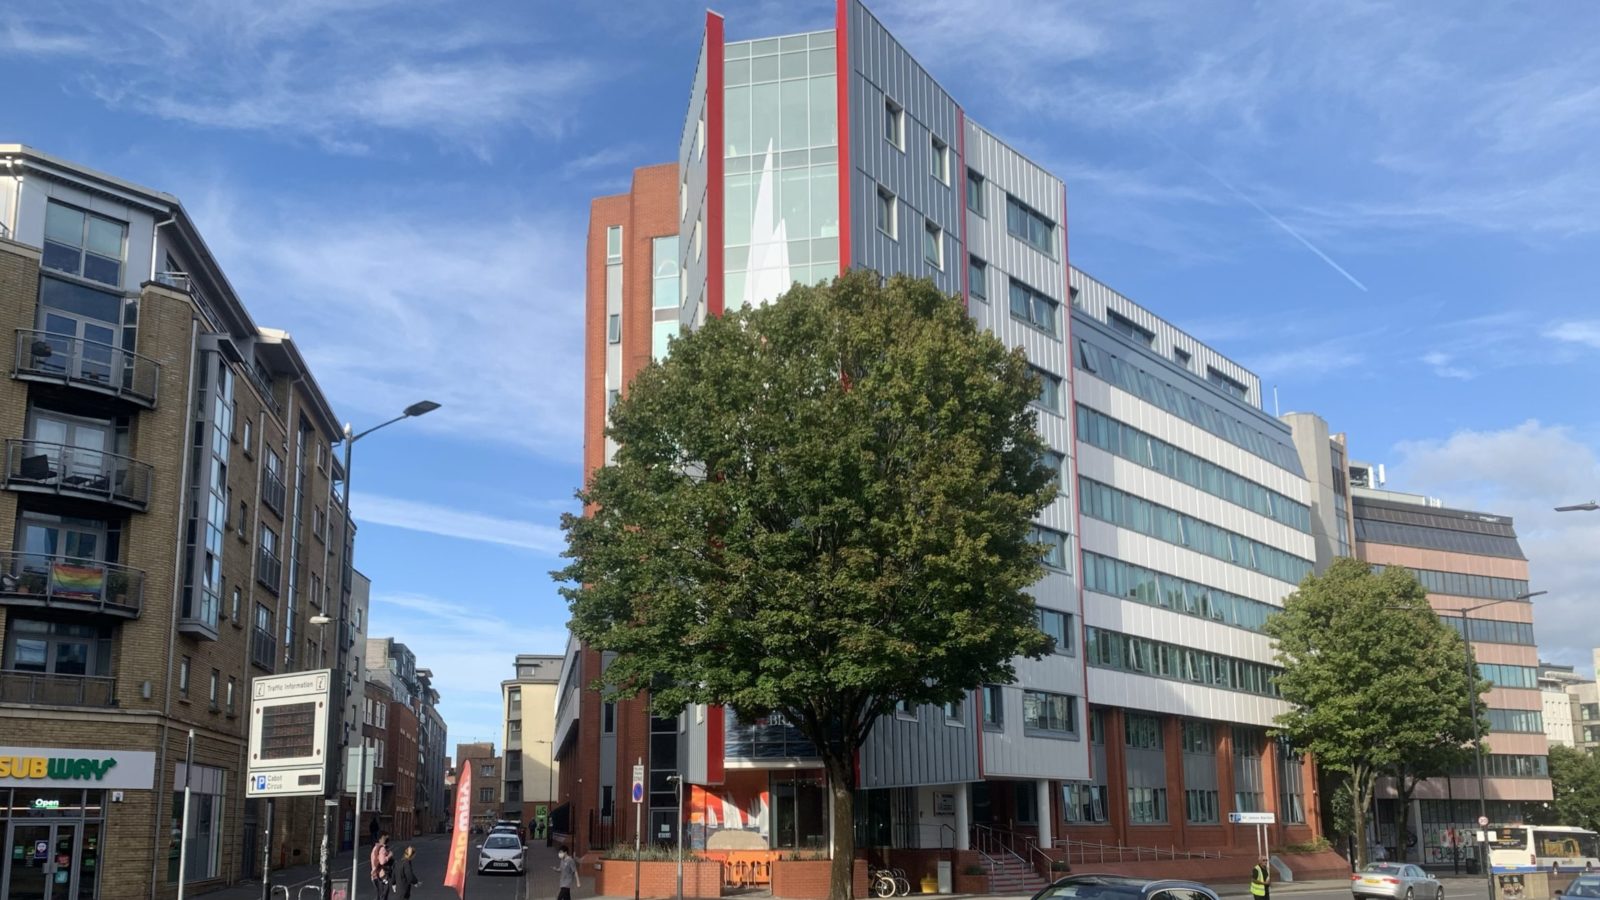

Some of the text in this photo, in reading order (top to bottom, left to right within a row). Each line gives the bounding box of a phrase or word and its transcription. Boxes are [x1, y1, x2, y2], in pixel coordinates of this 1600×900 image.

[284, 682, 313, 690] Information
[0, 756, 116, 780] SUBWAY
[35, 798, 59, 807] Open
